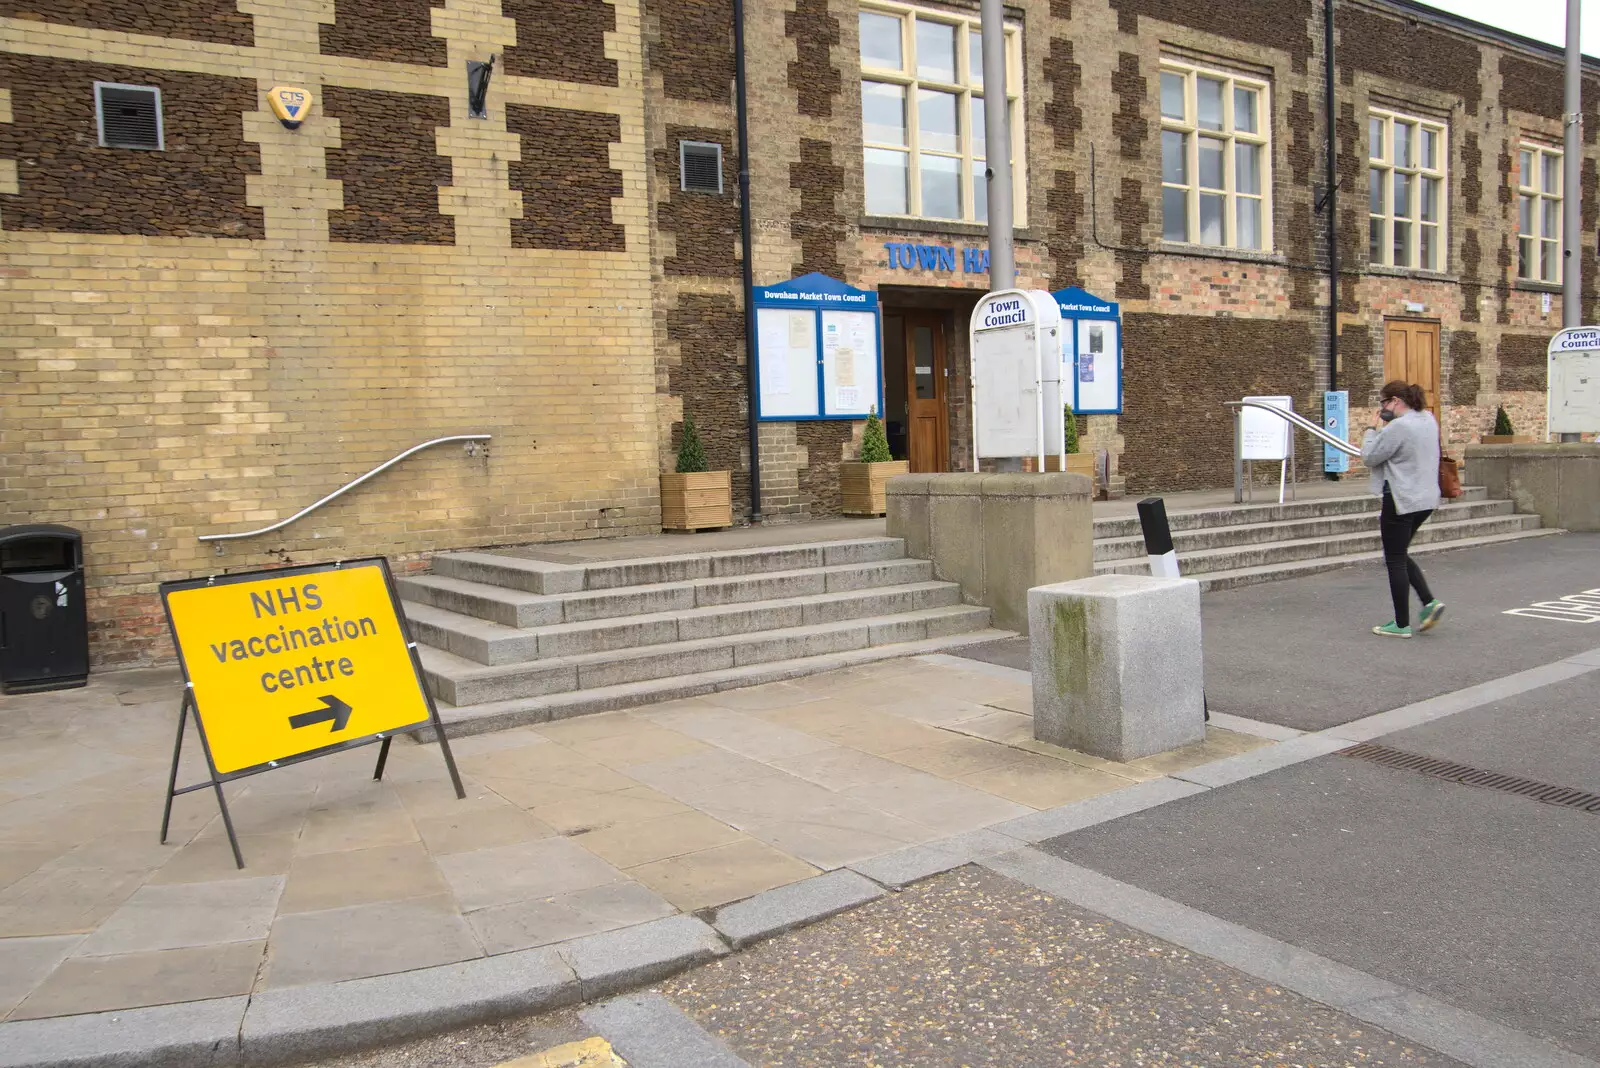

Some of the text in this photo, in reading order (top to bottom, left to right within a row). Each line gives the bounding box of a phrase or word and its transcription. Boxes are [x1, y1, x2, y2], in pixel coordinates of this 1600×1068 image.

[279, 91, 304, 101] CTS
[884, 242, 955, 271] TOWN
[764, 291, 866, 302] Downham Market Town Council
[989, 300, 1020, 313] Town
[985, 309, 1026, 327] Council
[1567, 331, 1596, 339] Town
[250, 583, 323, 618] NHS
[210, 616, 377, 663] vaccination
[260, 656, 354, 693] centre
